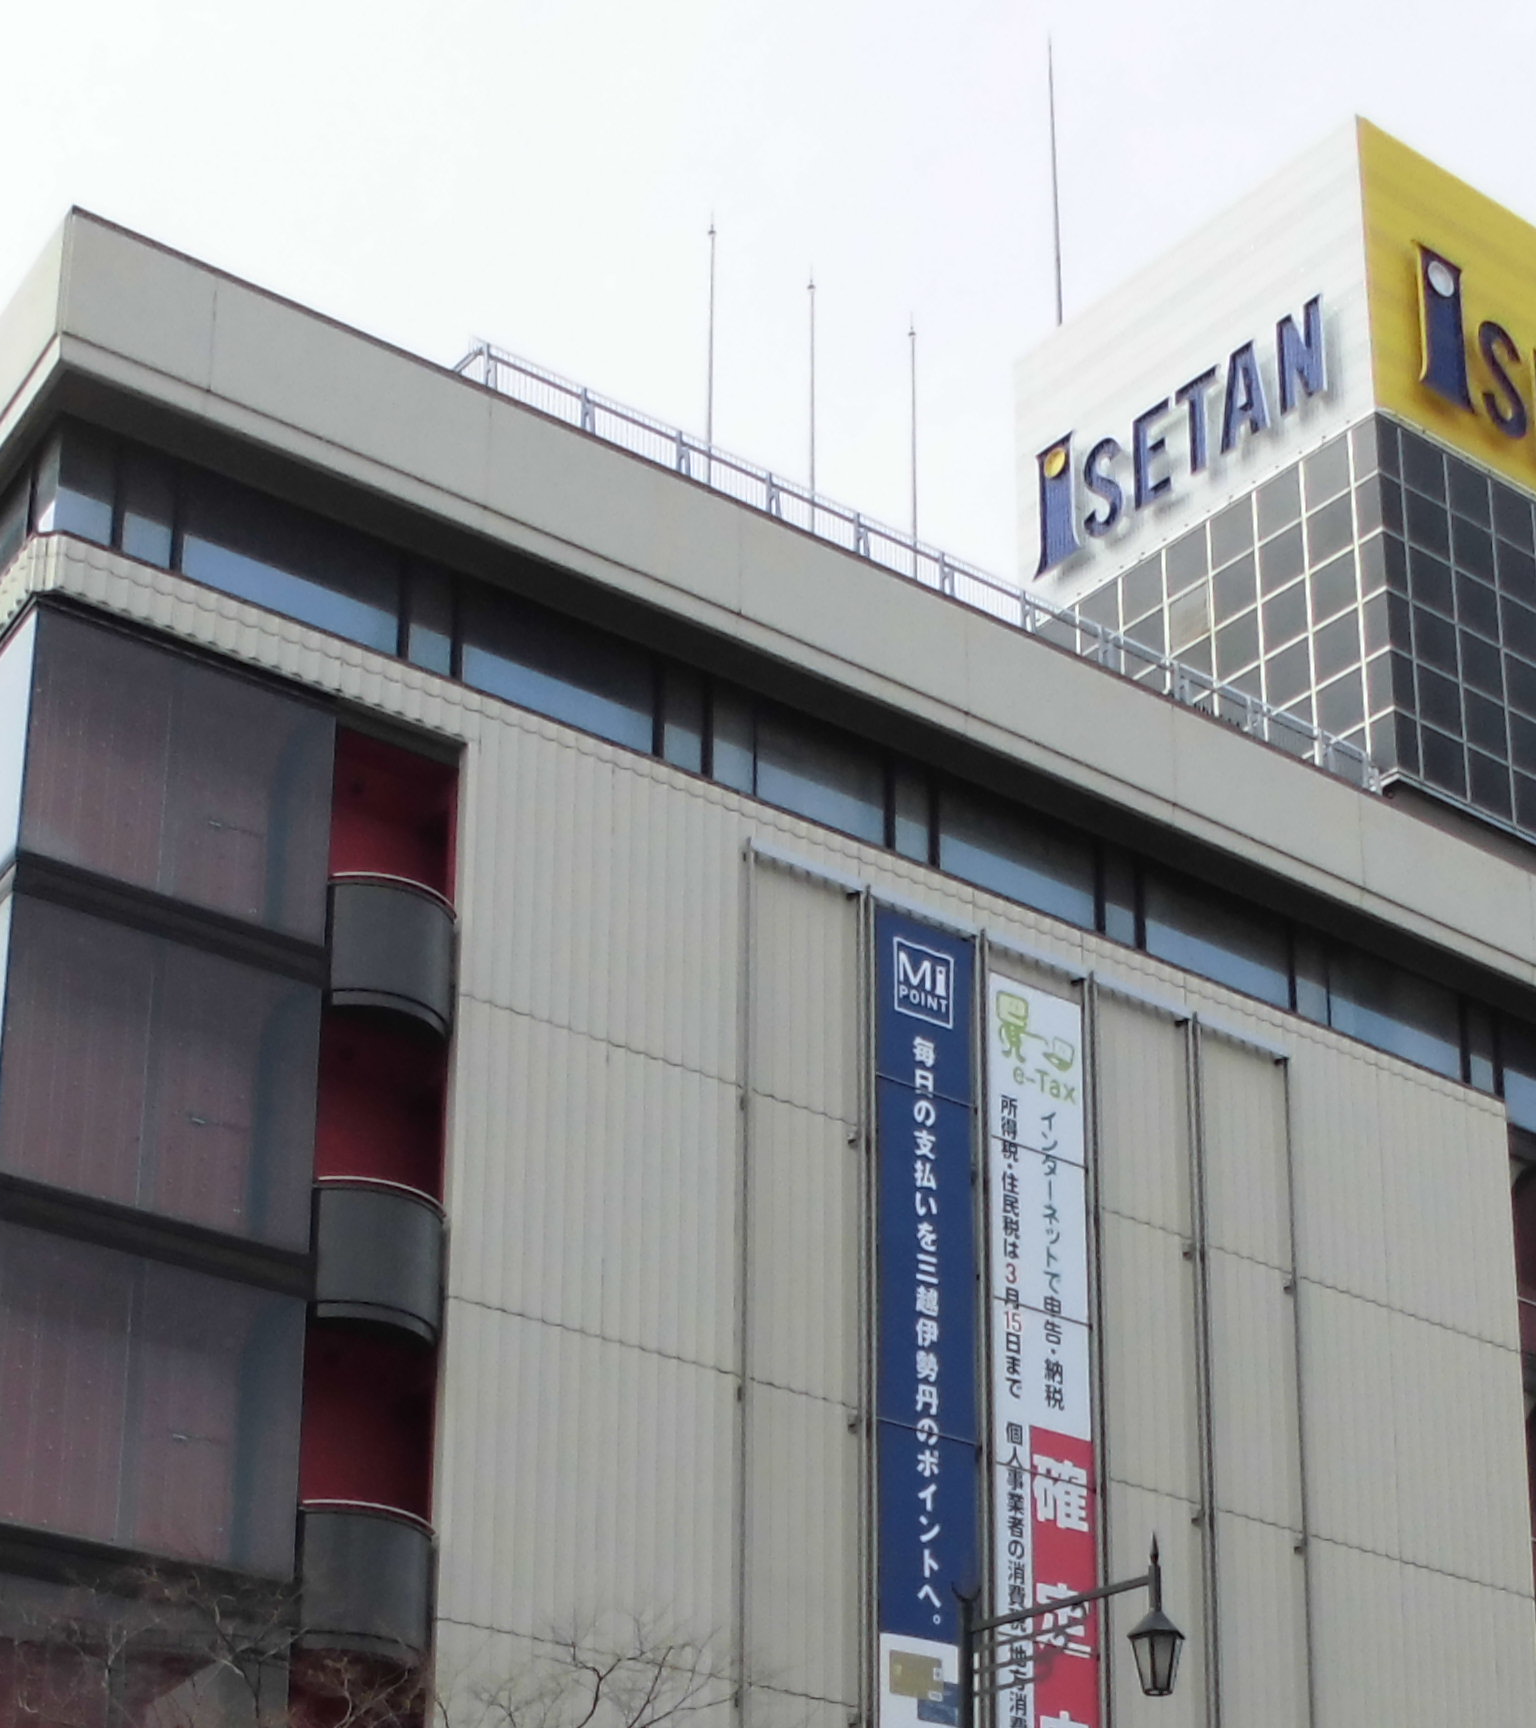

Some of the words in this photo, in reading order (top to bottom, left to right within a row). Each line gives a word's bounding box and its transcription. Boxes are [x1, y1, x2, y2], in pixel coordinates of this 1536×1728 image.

[1034, 293, 1329, 582] ISETAN
[899, 984, 948, 1013] POINT
[1013, 1066, 1075, 1105] e-Tax
